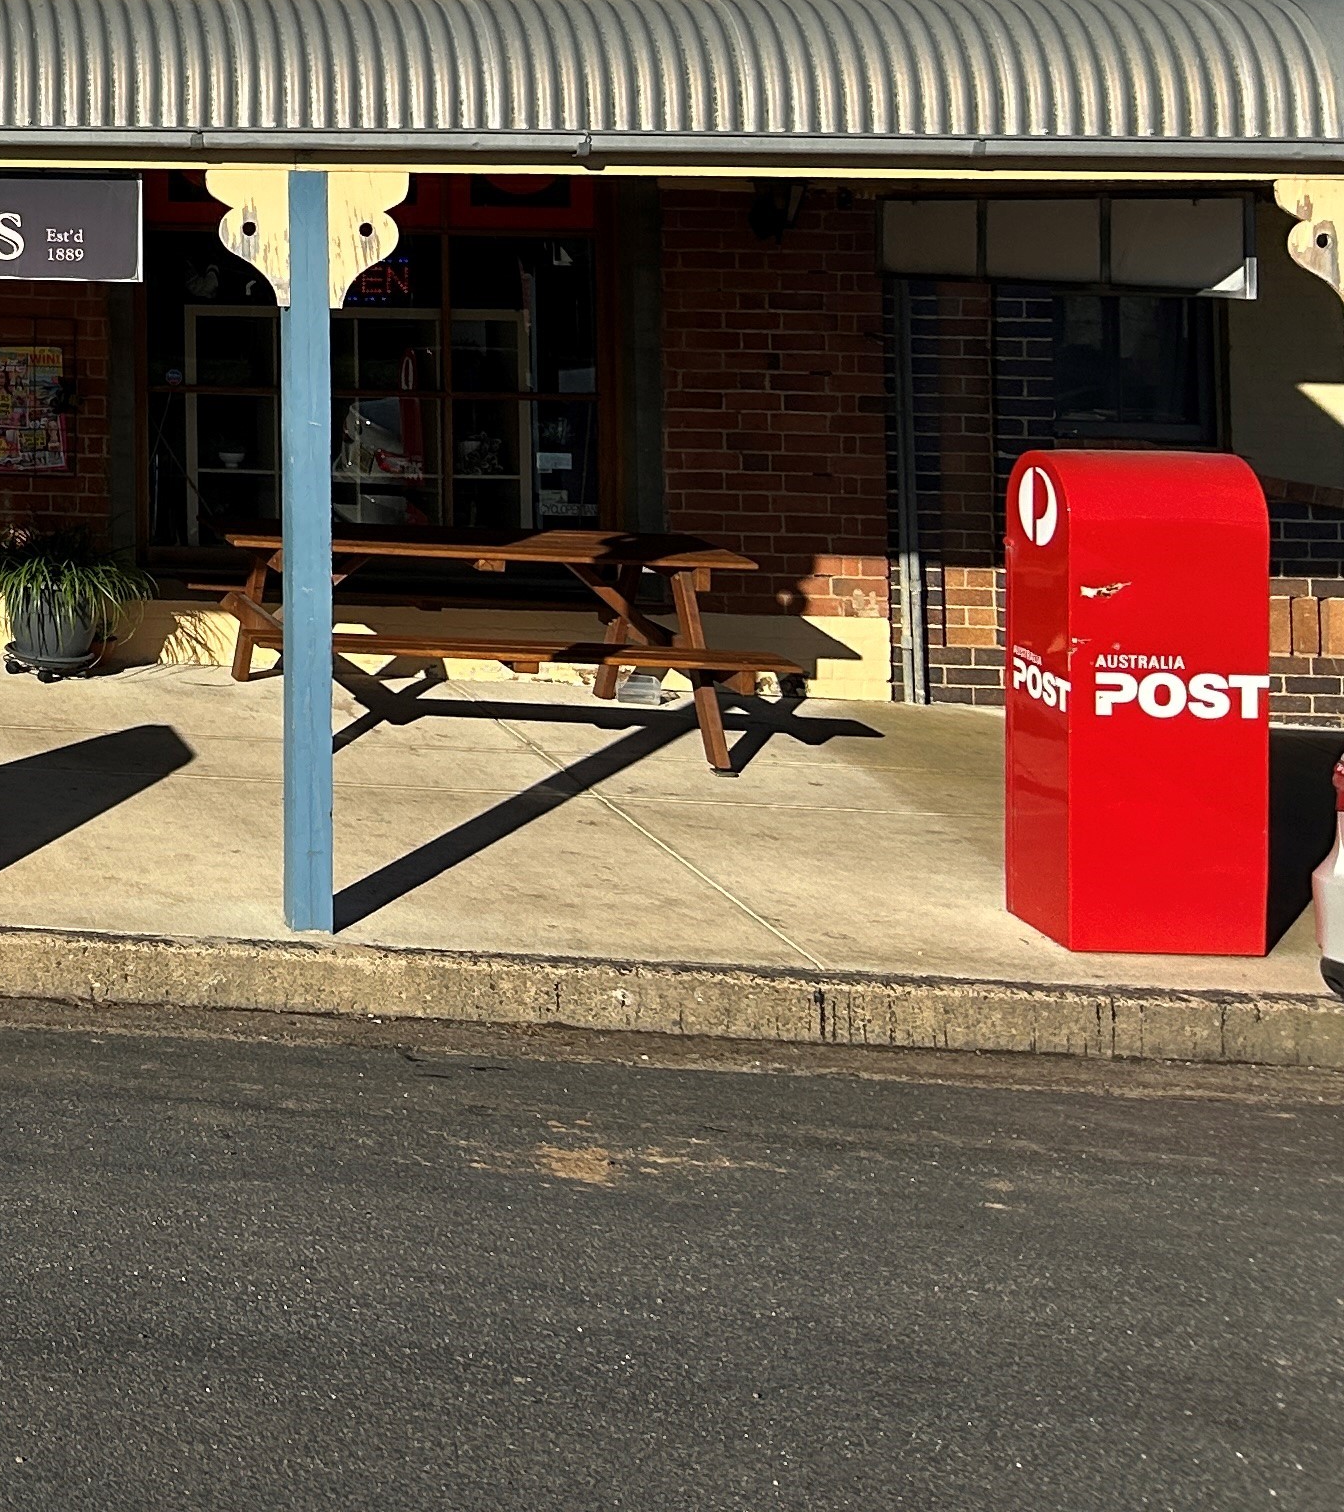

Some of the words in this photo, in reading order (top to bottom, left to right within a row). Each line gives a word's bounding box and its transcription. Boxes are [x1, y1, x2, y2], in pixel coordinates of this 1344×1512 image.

[45, 228, 85, 244] Est'd
[47, 247, 85, 262] 1889
[1094, 653, 1186, 670] AUSTRALIA
[1012, 656, 1072, 713] POST
[1094, 671, 1271, 720] POST
